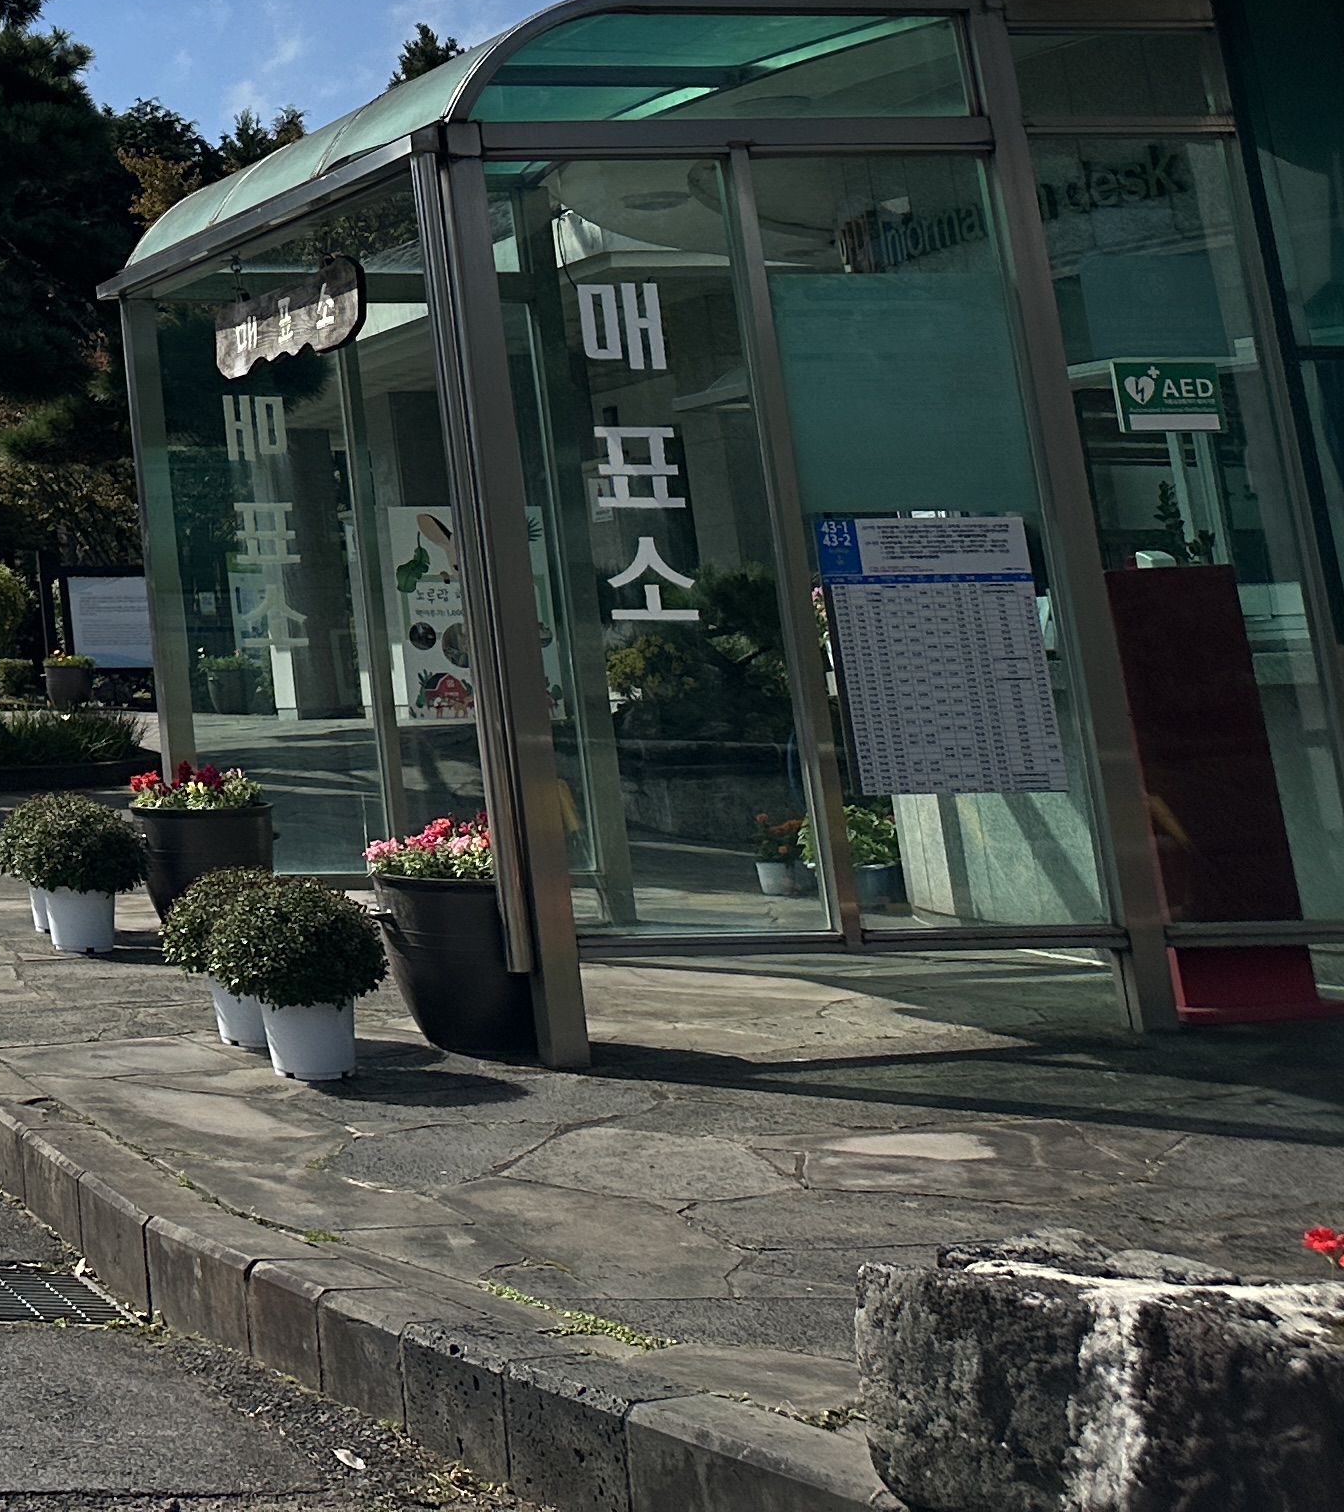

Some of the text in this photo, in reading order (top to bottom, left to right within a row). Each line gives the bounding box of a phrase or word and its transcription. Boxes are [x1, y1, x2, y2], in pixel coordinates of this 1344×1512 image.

[1068, 144, 1186, 212] desk
[235, 282, 335, 354] 매표소
[1162, 378, 1214, 398] AED
[577, 282, 700, 621] 매표소
[820, 521, 849, 534] 43-1
[823, 533, 853, 547] 43-2
